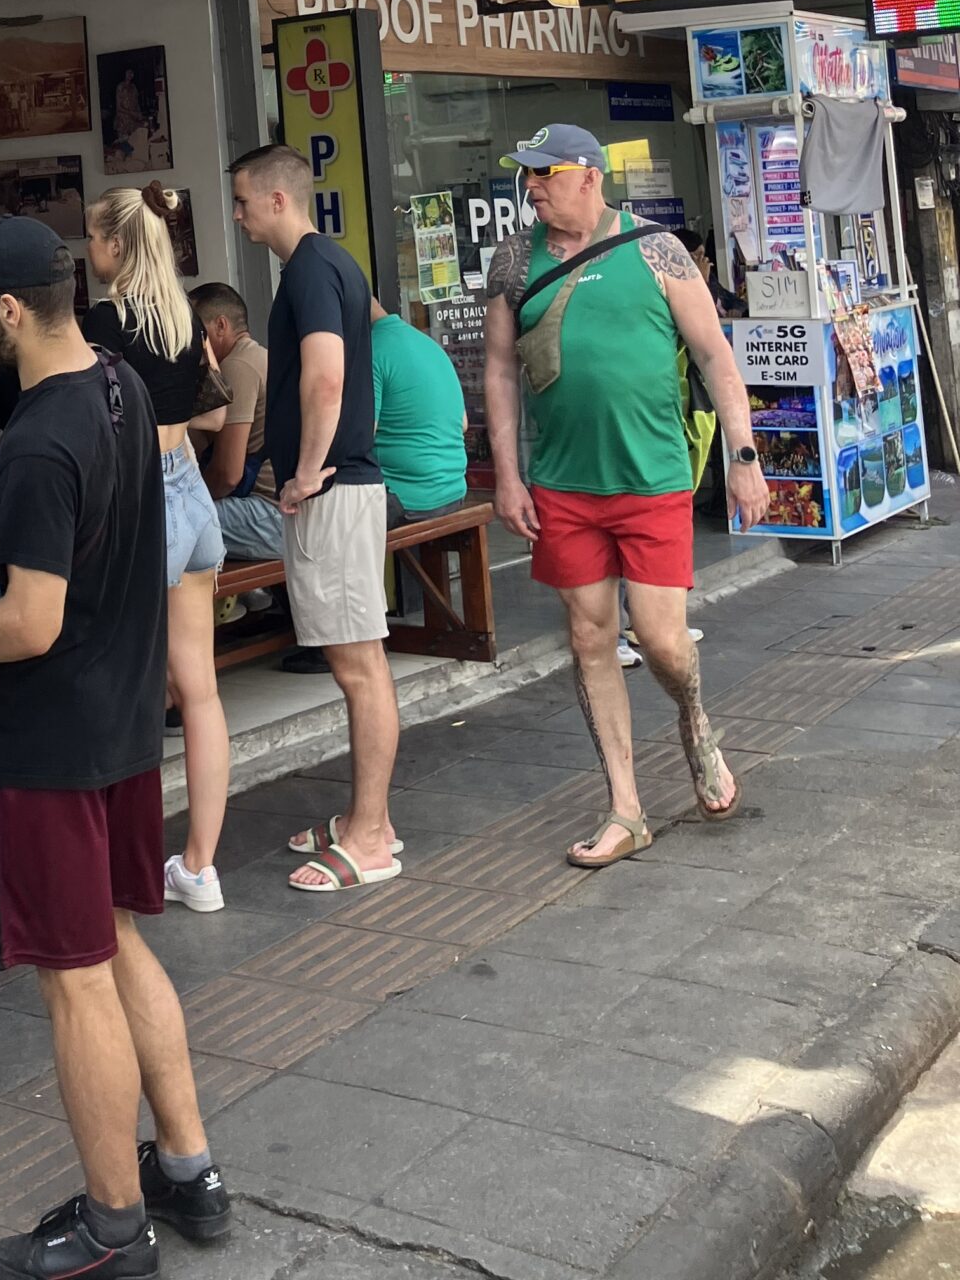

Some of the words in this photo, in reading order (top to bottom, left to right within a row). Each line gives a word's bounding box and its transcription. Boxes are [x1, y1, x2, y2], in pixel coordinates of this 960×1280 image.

[761, 275, 797, 298] SIM
[437, 308, 460, 320] OPEN
[463, 306, 487, 318] DAILY
[776, 325, 806, 338] 5G
[746, 341, 808, 352] INTERNET
[747, 355, 770, 366] SIM
[775, 355, 809, 366] CARD
[761, 371, 797, 381] E-SIM
